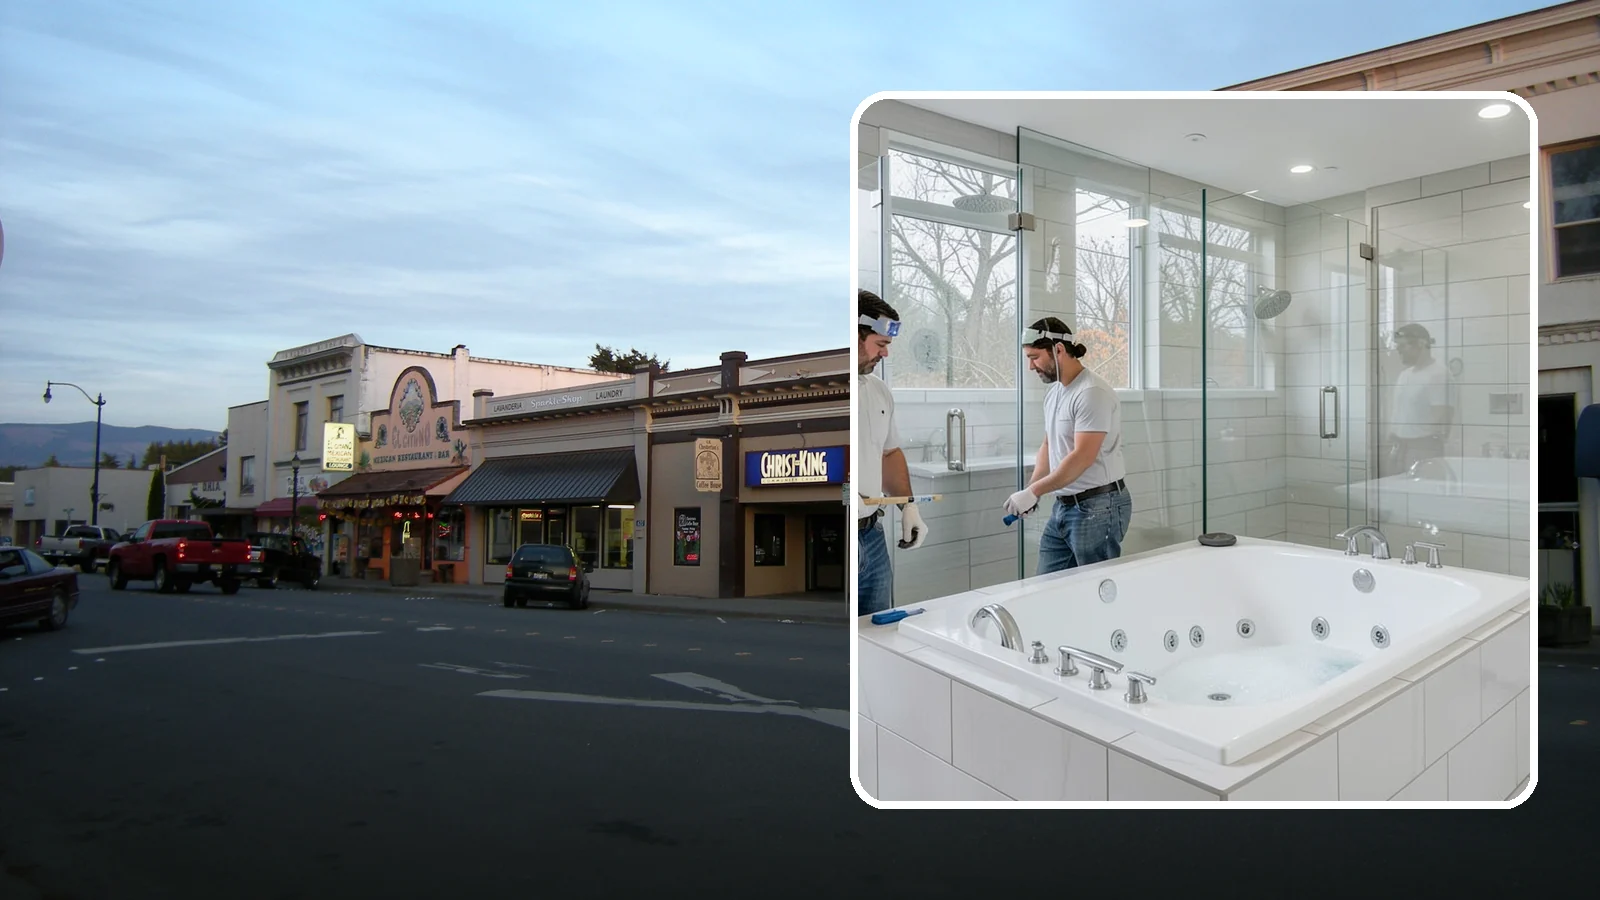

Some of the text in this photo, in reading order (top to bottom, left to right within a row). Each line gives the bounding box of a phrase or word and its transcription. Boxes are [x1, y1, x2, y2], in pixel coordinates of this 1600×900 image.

[530, 394, 583, 409] Sparkle Shop
[595, 389, 624, 400] LAUNDRY
[493, 402, 523, 412] LAVANDERIA
[374, 455, 396, 464] MEXICAN
[397, 451, 434, 462] RESTAURANT
[438, 450, 450, 459] BAR
[799, 450, 827, 476] KING
